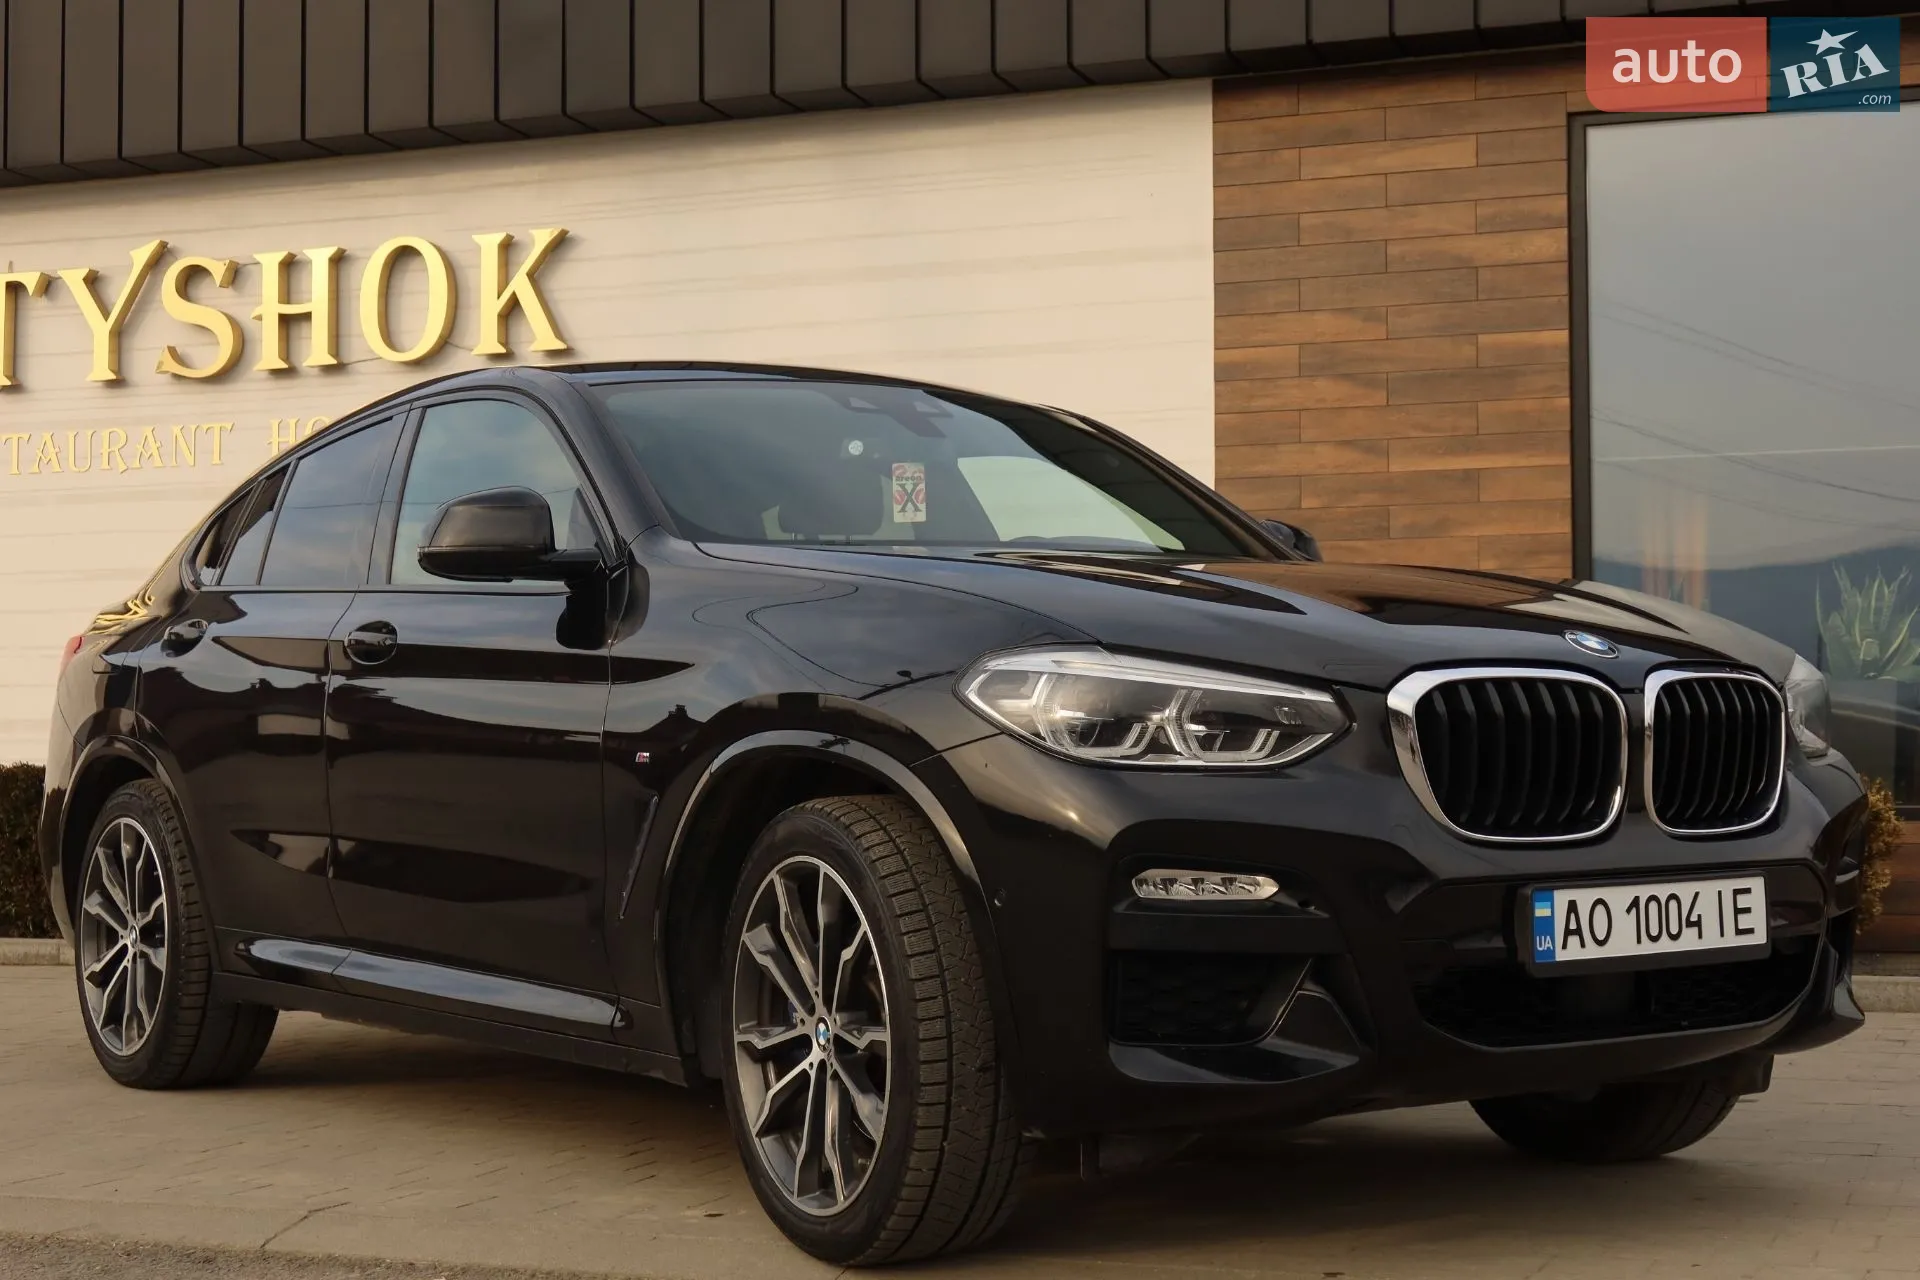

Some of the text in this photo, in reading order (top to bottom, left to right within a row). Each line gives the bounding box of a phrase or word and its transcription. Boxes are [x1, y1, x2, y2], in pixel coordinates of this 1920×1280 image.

[0, 422, 235, 476] TAURANT
[896, 482, 923, 513] X
[1561, 887, 1755, 950] AO 1004 IE
[1536, 936, 1553, 950] UA
